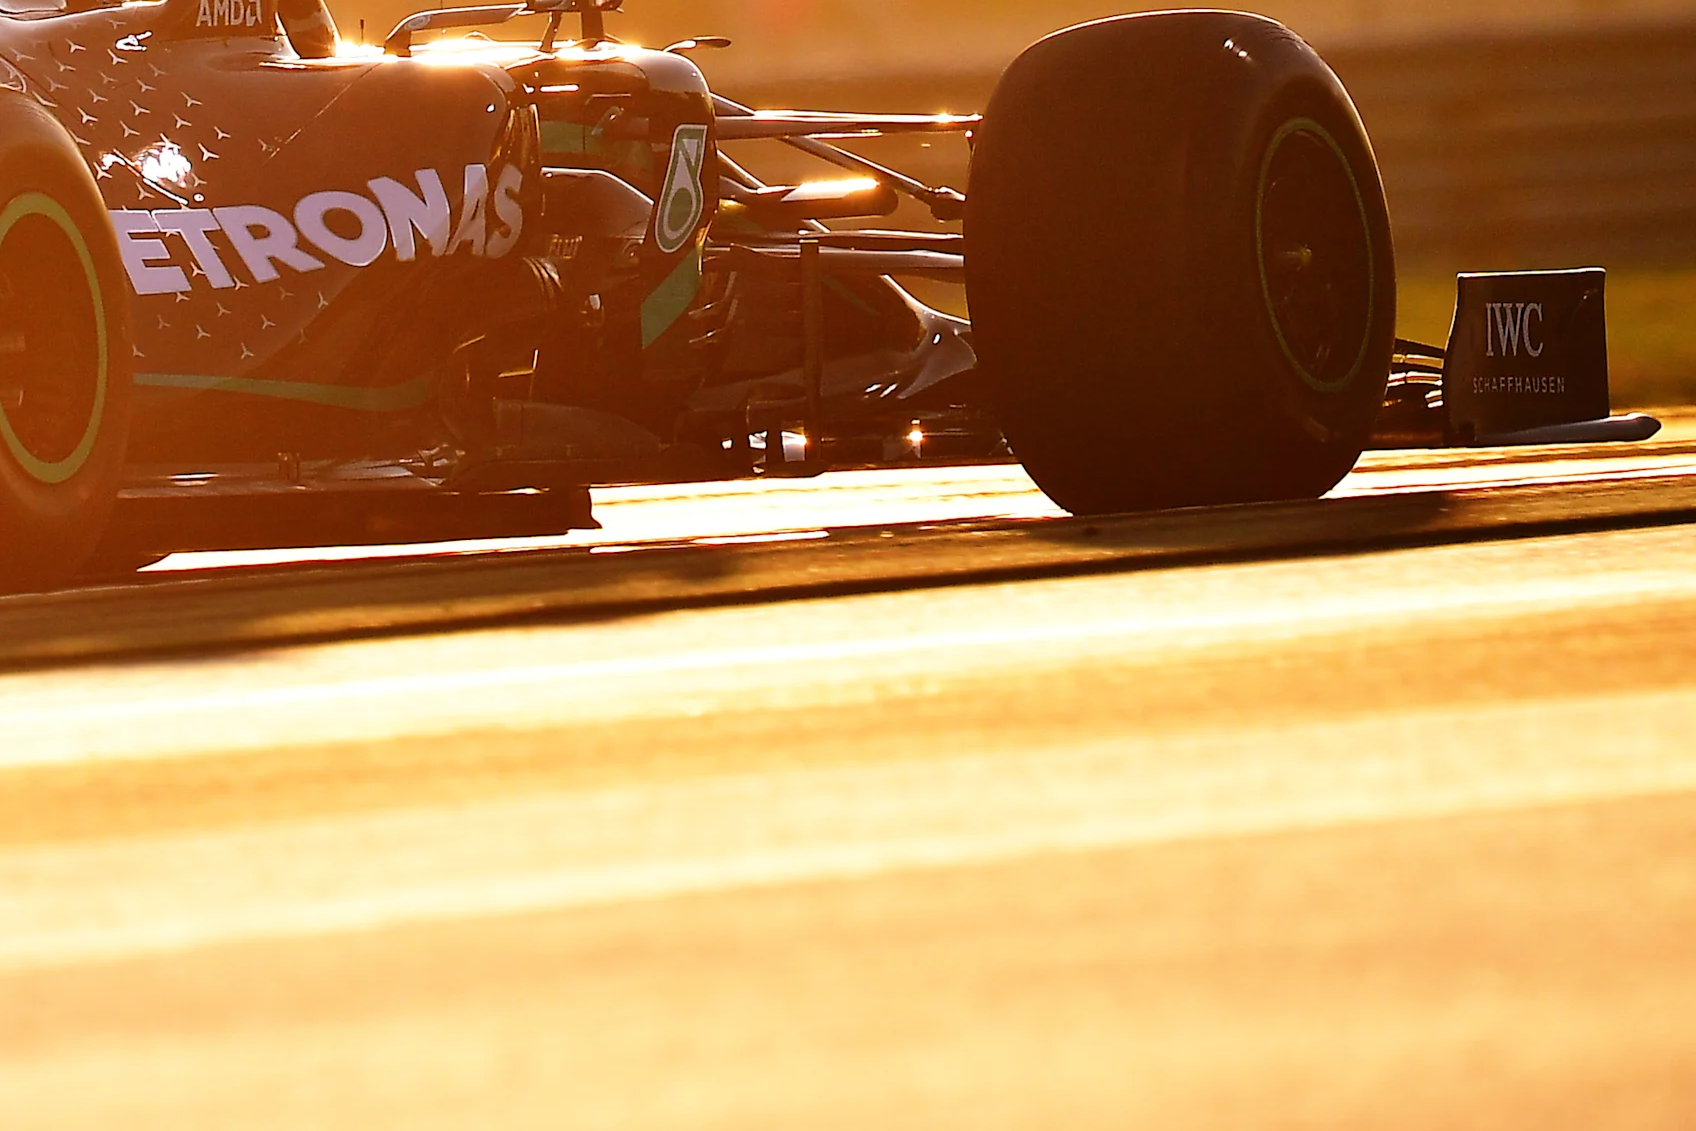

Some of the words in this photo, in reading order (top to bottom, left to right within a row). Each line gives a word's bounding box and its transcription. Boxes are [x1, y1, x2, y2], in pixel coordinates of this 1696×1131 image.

[108, 164, 523, 295] ETRONAS
[1486, 302, 1543, 357] IWC
[1473, 376, 1565, 394] SCHAFFHAUSEN
